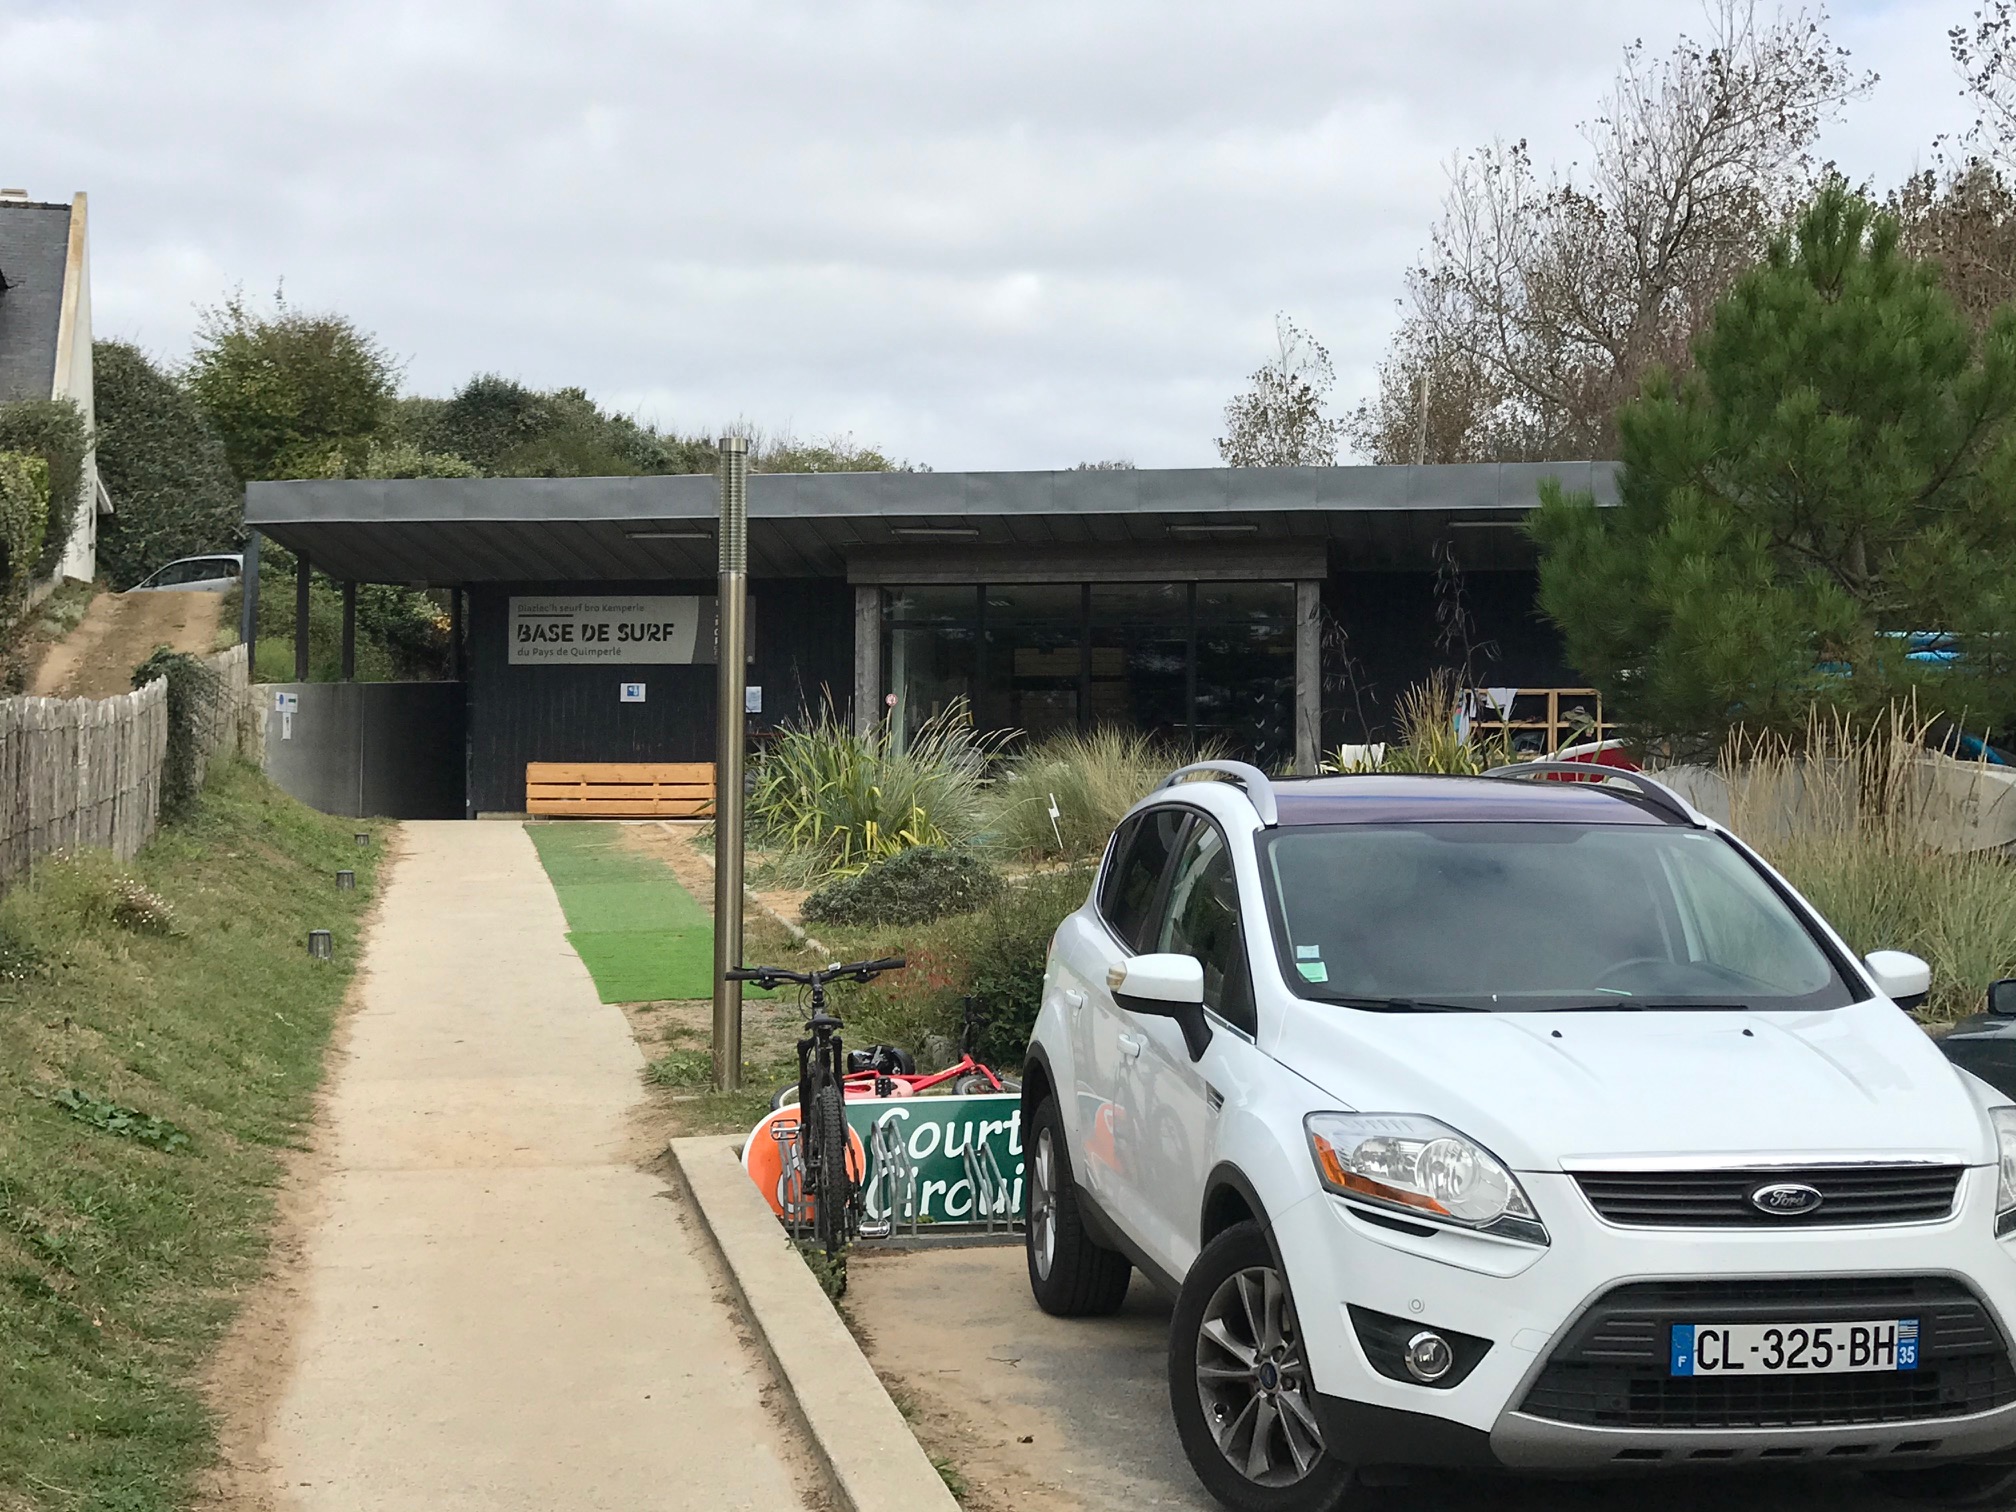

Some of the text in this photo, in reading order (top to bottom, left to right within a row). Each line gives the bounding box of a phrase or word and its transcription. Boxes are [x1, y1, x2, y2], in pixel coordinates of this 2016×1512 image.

[560, 603, 583, 612] seurf
[584, 603, 600, 612] bro
[517, 622, 675, 643] BASE DE SURF
[517, 646, 622, 659] du Pays de Quimperlé
[870, 1106, 1023, 1160] Court
[865, 1162, 1026, 1219] Circui
[1769, 1189, 1806, 1207] Ford
[1677, 1325, 1915, 1370] F CL-325-BH 35
